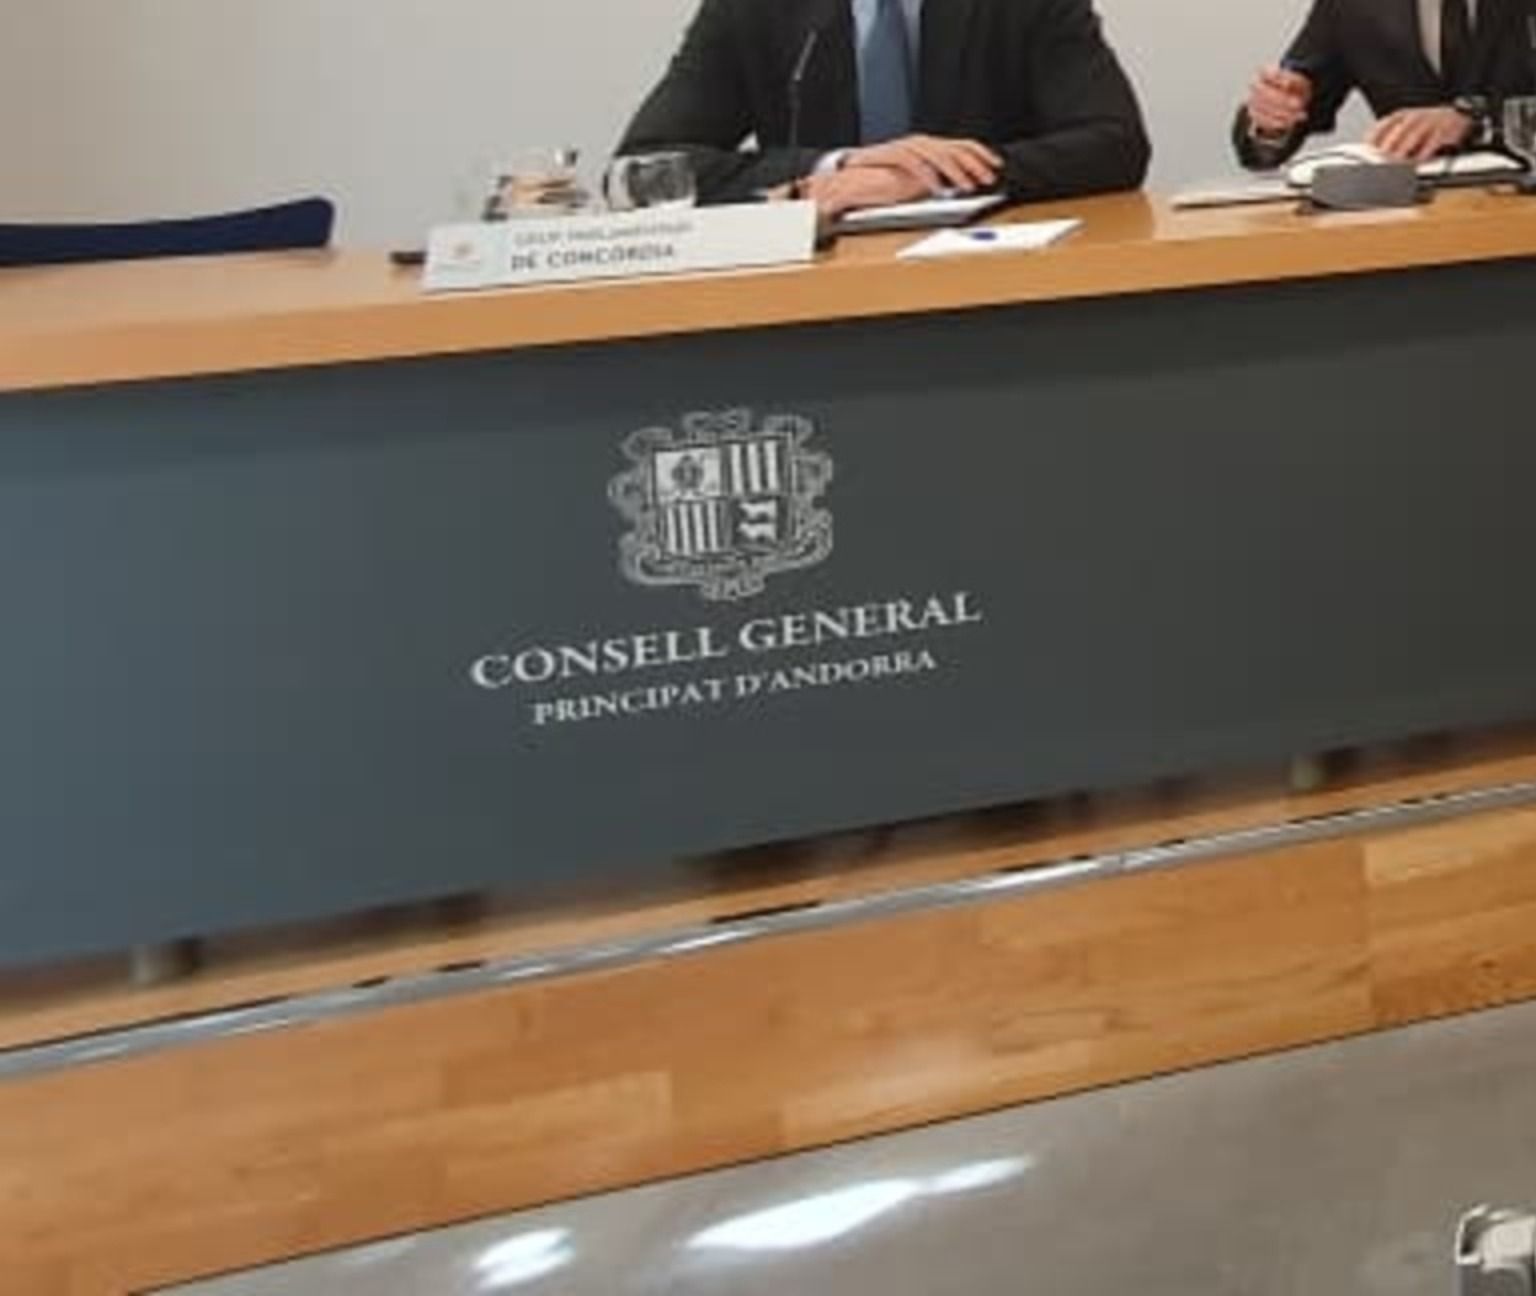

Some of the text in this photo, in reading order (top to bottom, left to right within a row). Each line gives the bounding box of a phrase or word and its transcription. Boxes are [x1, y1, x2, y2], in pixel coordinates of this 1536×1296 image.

[470, 591, 983, 689] CONSELL GENERAL
[532, 650, 938, 726] PRINCIPAT D'ANDORRA
